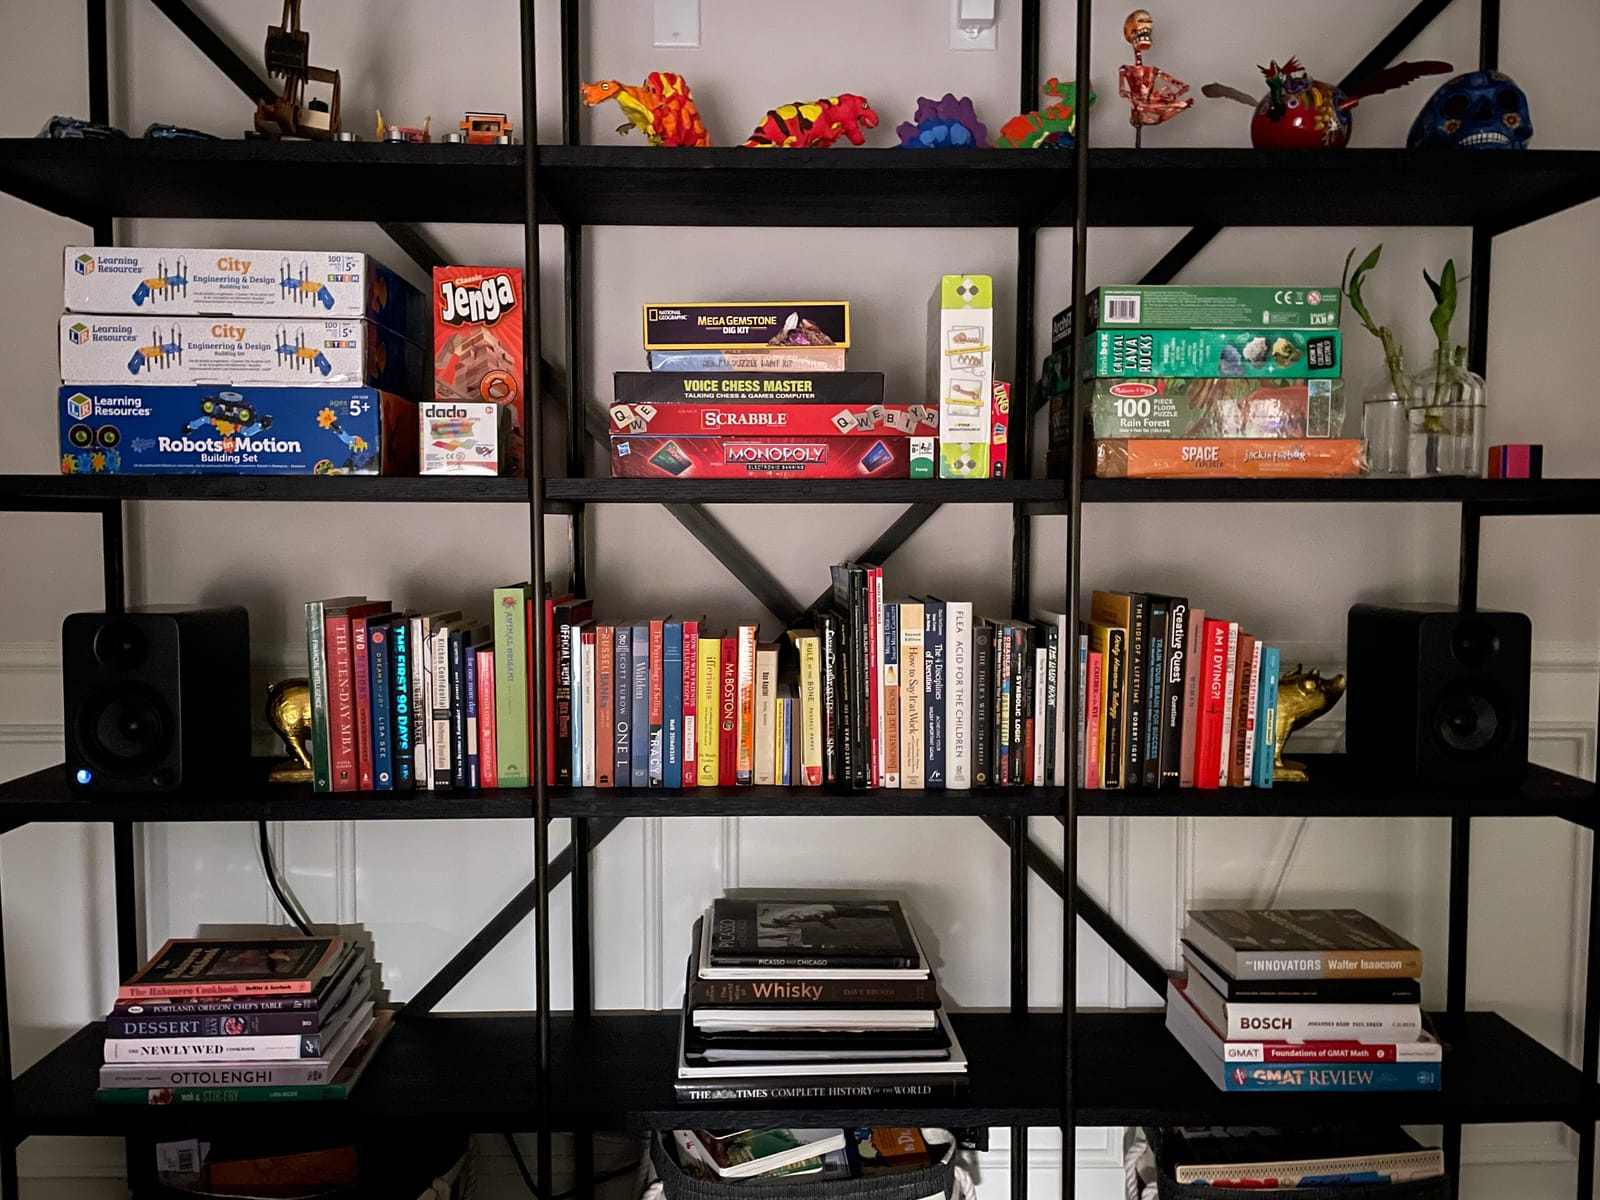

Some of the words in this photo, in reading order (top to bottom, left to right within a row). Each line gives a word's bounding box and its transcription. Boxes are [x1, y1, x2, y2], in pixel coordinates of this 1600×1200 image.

[98, 256, 138, 267] Learning
[98, 265, 143, 273] Resources
[217, 257, 251, 274] City
[328, 255, 341, 263] 100
[192, 275, 240, 284] Engineering
[250, 276, 276, 285] Design
[455, 274, 483, 285] Classic
[441, 273, 515, 322] Jenga
[92, 324, 132, 335] Learning
[697, 316, 725, 326] MEGA
[726, 315, 777, 326] GEMSTONE
[722, 326, 736, 334] DIG
[737, 326, 750, 334] KIT
[92, 333, 137, 342] Resources
[211, 324, 246, 341] City
[187, 342, 236, 352] Engineering
[244, 343, 272, 352] Design
[1100, 333, 1109, 375] thinkbox
[1113, 334, 1124, 373] CRYSTAL
[1125, 338, 1139, 369] LAVA
[1139, 334, 1153, 372] ROCKS
[683, 380, 720, 392] VOICE
[721, 380, 761, 392] CHESS
[763, 380, 813, 391] MASTER
[94, 396, 142, 408] Learning
[350, 400, 371, 416] 5+
[993, 381, 1009, 414] UNO
[1113, 398, 1151, 417] 100
[94, 406, 150, 416] Resources
[425, 404, 468, 418] dado
[705, 412, 787, 426] SCRABBLE
[1120, 418, 1141, 427] Rain
[1143, 418, 1170, 427] Forest
[158, 436, 223, 453] Robots
[223, 440, 234, 449] in
[234, 437, 302, 453] Motion
[728, 447, 824, 462] MONOPOLY
[1182, 446, 1218, 461] SPACE
[201, 453, 240, 464] Building
[242, 454, 258, 463] Set
[955, 610, 964, 633] FLEA
[1135, 603, 1143, 619] THE
[505, 612, 514, 647] ANIMAL
[653, 631, 661, 643] The
[1173, 604, 1186, 650] Creative
[1214, 627, 1224, 646] AM
[335, 624, 347, 655] THE
[355, 627, 365, 650] TWO
[393, 625, 405, 653] THE
[559, 624, 570, 660] OFFICIAL
[1111, 634, 1122, 656] Dirty
[1135, 643, 1142, 655] OF
[1155, 638, 1163, 661] TRAIN
[312, 639, 320, 669] FINANCIAL
[437, 638, 446, 664] Kitchen
[908, 647, 918, 669] How
[935, 644, 943, 656] The
[955, 640, 964, 664] ACID
[396, 654, 407, 693] FIRST
[507, 648, 515, 683] ORIGAMI
[561, 662, 571, 686] TRUTH
[651, 644, 661, 682] Psychology
[1112, 657, 1121, 689] Havana
[1154, 662, 1162, 683] YOUR
[1171, 650, 1183, 683] Quest
[437, 666, 447, 708] Confidential
[634, 661, 646, 700] Walden
[706, 656, 716, 700] ifferisms
[906, 679, 918, 695] Say
[925, 659, 933, 693] Execution
[933, 664, 943, 700] Disciplines
[955, 666, 964, 686] FOR
[1092, 666, 1100, 694] CATCHER
[1133, 665, 1141, 704] LIFETIME
[1211, 655, 1223, 700] DYING?!
[313, 669, 322, 709] INTELLIGENCE
[338, 658, 351, 720] TEN-DAY
[599, 674, 609, 709] BANKS
[724, 678, 735, 719] BOSTON
[807, 681, 815, 702] BONE
[955, 688, 964, 707] THE
[1049, 685, 1057, 708] BOOK
[1153, 684, 1161, 708] BRAIN
[1188, 675, 1196, 708] WOMEN
[397, 694, 408, 714] 90
[467, 700, 476, 714] day
[652, 691, 661, 717] Selling
[1110, 690, 1120, 720] Trilogy
[1169, 695, 1178, 727] Questlove
[1240, 697, 1249, 728] GARDEN
[378, 716, 386, 737] LISA
[397, 715, 409, 750] DAYS
[908, 712, 918, 735] Work
[955, 709, 964, 758] CHILDREN
[341, 724, 352, 755] MBA
[617, 721, 629, 753] ONE
[1151, 726, 1159, 759] SUCCESS
[650, 731, 660, 774] TRACY
[1253, 959, 1321, 971] INNOVATORS
[1328, 960, 1358, 970] Walter
[1360, 960, 1402, 970] Isaacson
[130, 988, 147, 997] The
[149, 986, 193, 996] Habanero
[195, 984, 239, 995] Cookbook
[752, 983, 824, 1001] Whisky
[153, 1004, 196, 1013] PORTLAND,
[198, 1003, 231, 1011] OREGON
[233, 1003, 259, 1011] CHEF'S
[261, 1002, 282, 1010] TABLE
[124, 1021, 200, 1035] DESSERT
[1240, 1017, 1292, 1030] BOSCH
[141, 1044, 224, 1056] NEWLYWED
[1228, 1048, 1260, 1058] GMAT
[1271, 1049, 1317, 1057] Foundations
[1318, 1049, 1326, 1057] of
[1327, 1049, 1349, 1057] GMAT
[1350, 1049, 1370, 1057] Math
[171, 1071, 273, 1084] OTTOLENGHI
[1253, 1070, 1305, 1084] GMAT
[1309, 1070, 1374, 1085] REVIEW
[203, 1090, 239, 1103] STIR-FRY
[689, 1090, 712, 1100] THE
[735, 1089, 768, 1099] TIMES
[771, 1087, 826, 1097] COMPLETE
[828, 1086, 872, 1096] HISTORY
[893, 1086, 932, 1095] WORLD
